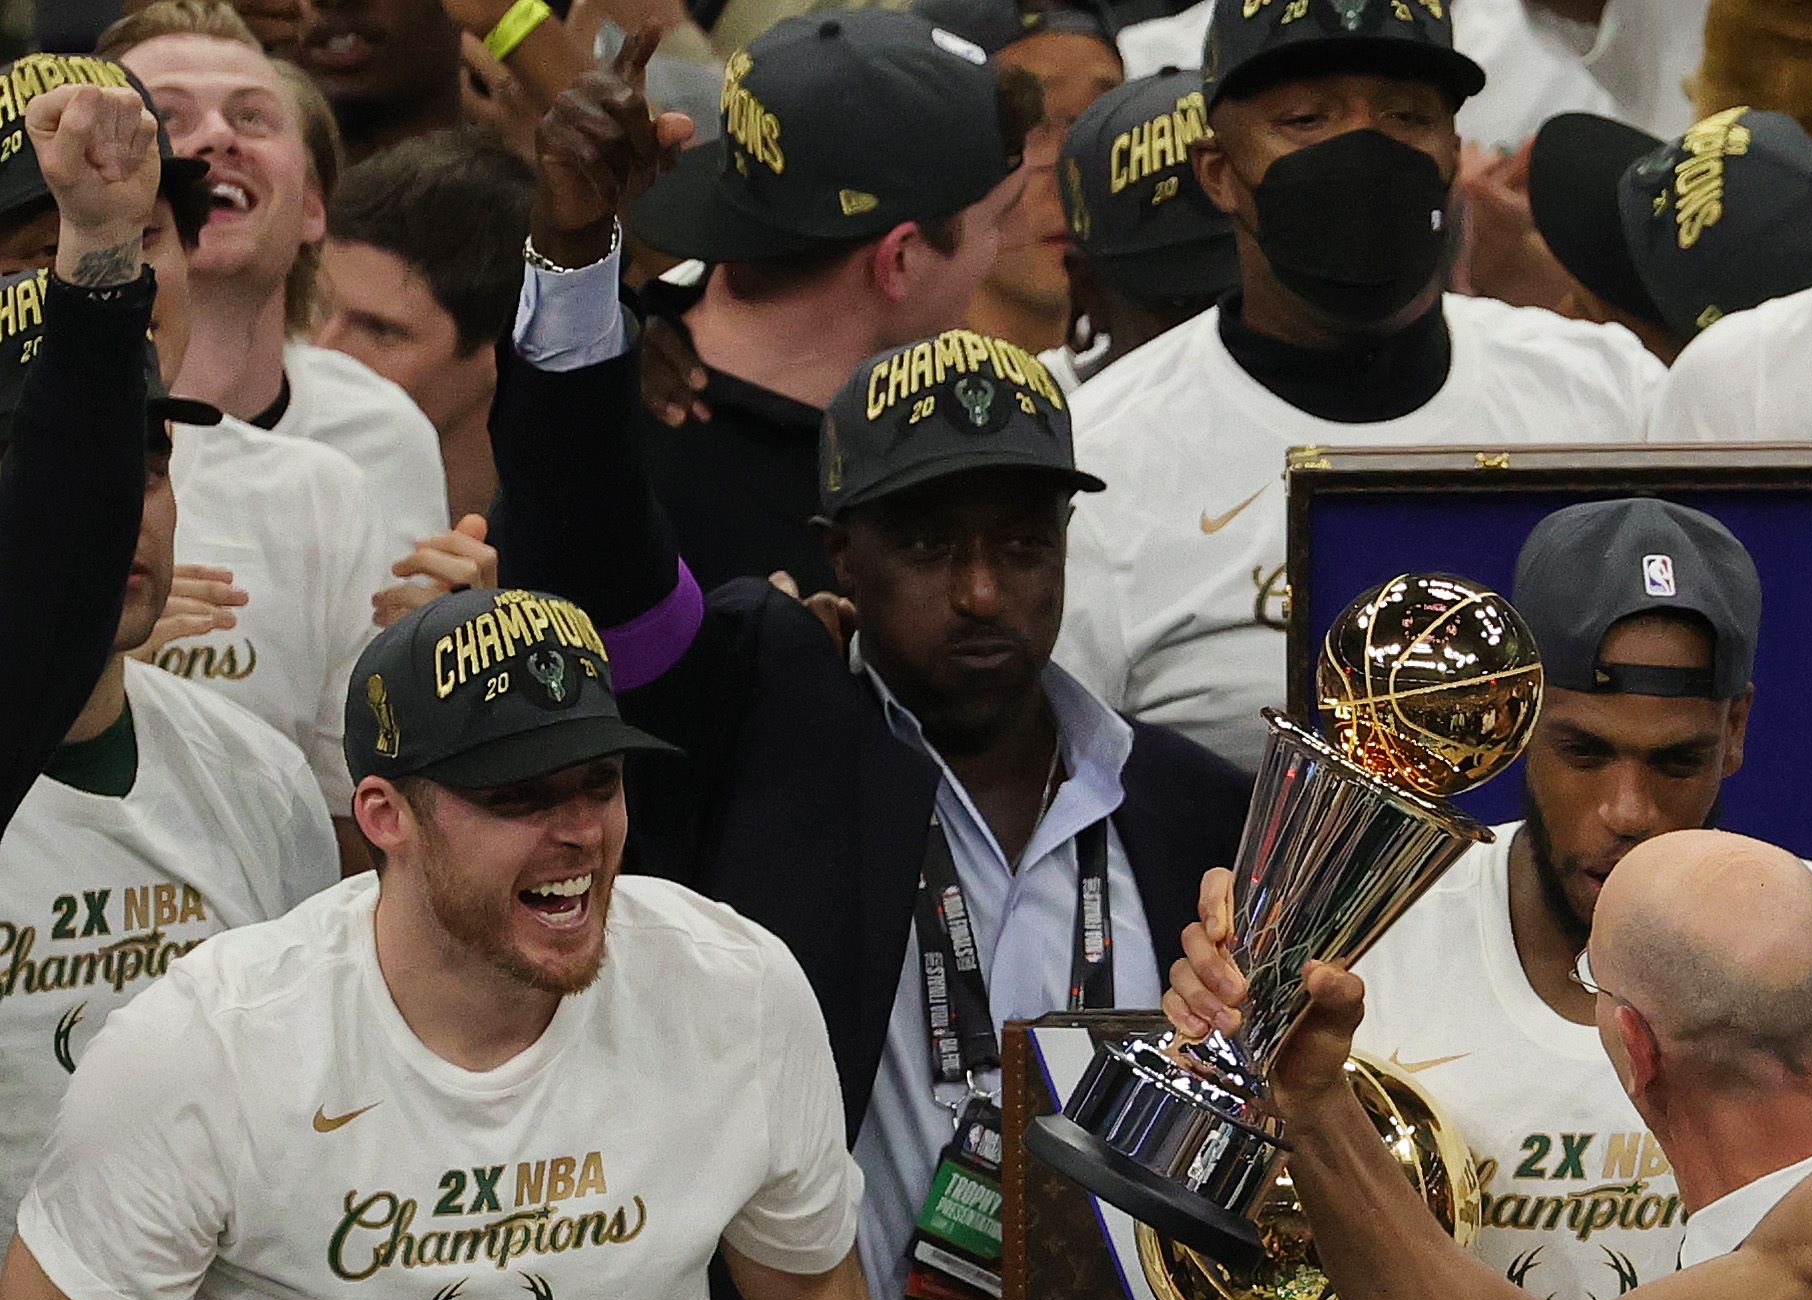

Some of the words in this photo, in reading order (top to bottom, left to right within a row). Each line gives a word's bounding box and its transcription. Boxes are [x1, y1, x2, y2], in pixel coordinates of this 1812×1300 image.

[867, 329, 1064, 422] CHAMPIONS
[909, 395, 935, 425] 20
[434, 599, 609, 699] CHAMPIONS
[484, 671, 510, 702] 20
[51, 888, 112, 941] 2X
[124, 881, 207, 932] NBA
[432, 1164, 508, 1217] 2X
[514, 1151, 608, 1207] NBA
[1513, 1132, 1597, 1181] 2X
[1601, 1132, 1674, 1180] NB
[327, 1188, 649, 1282] Champions
